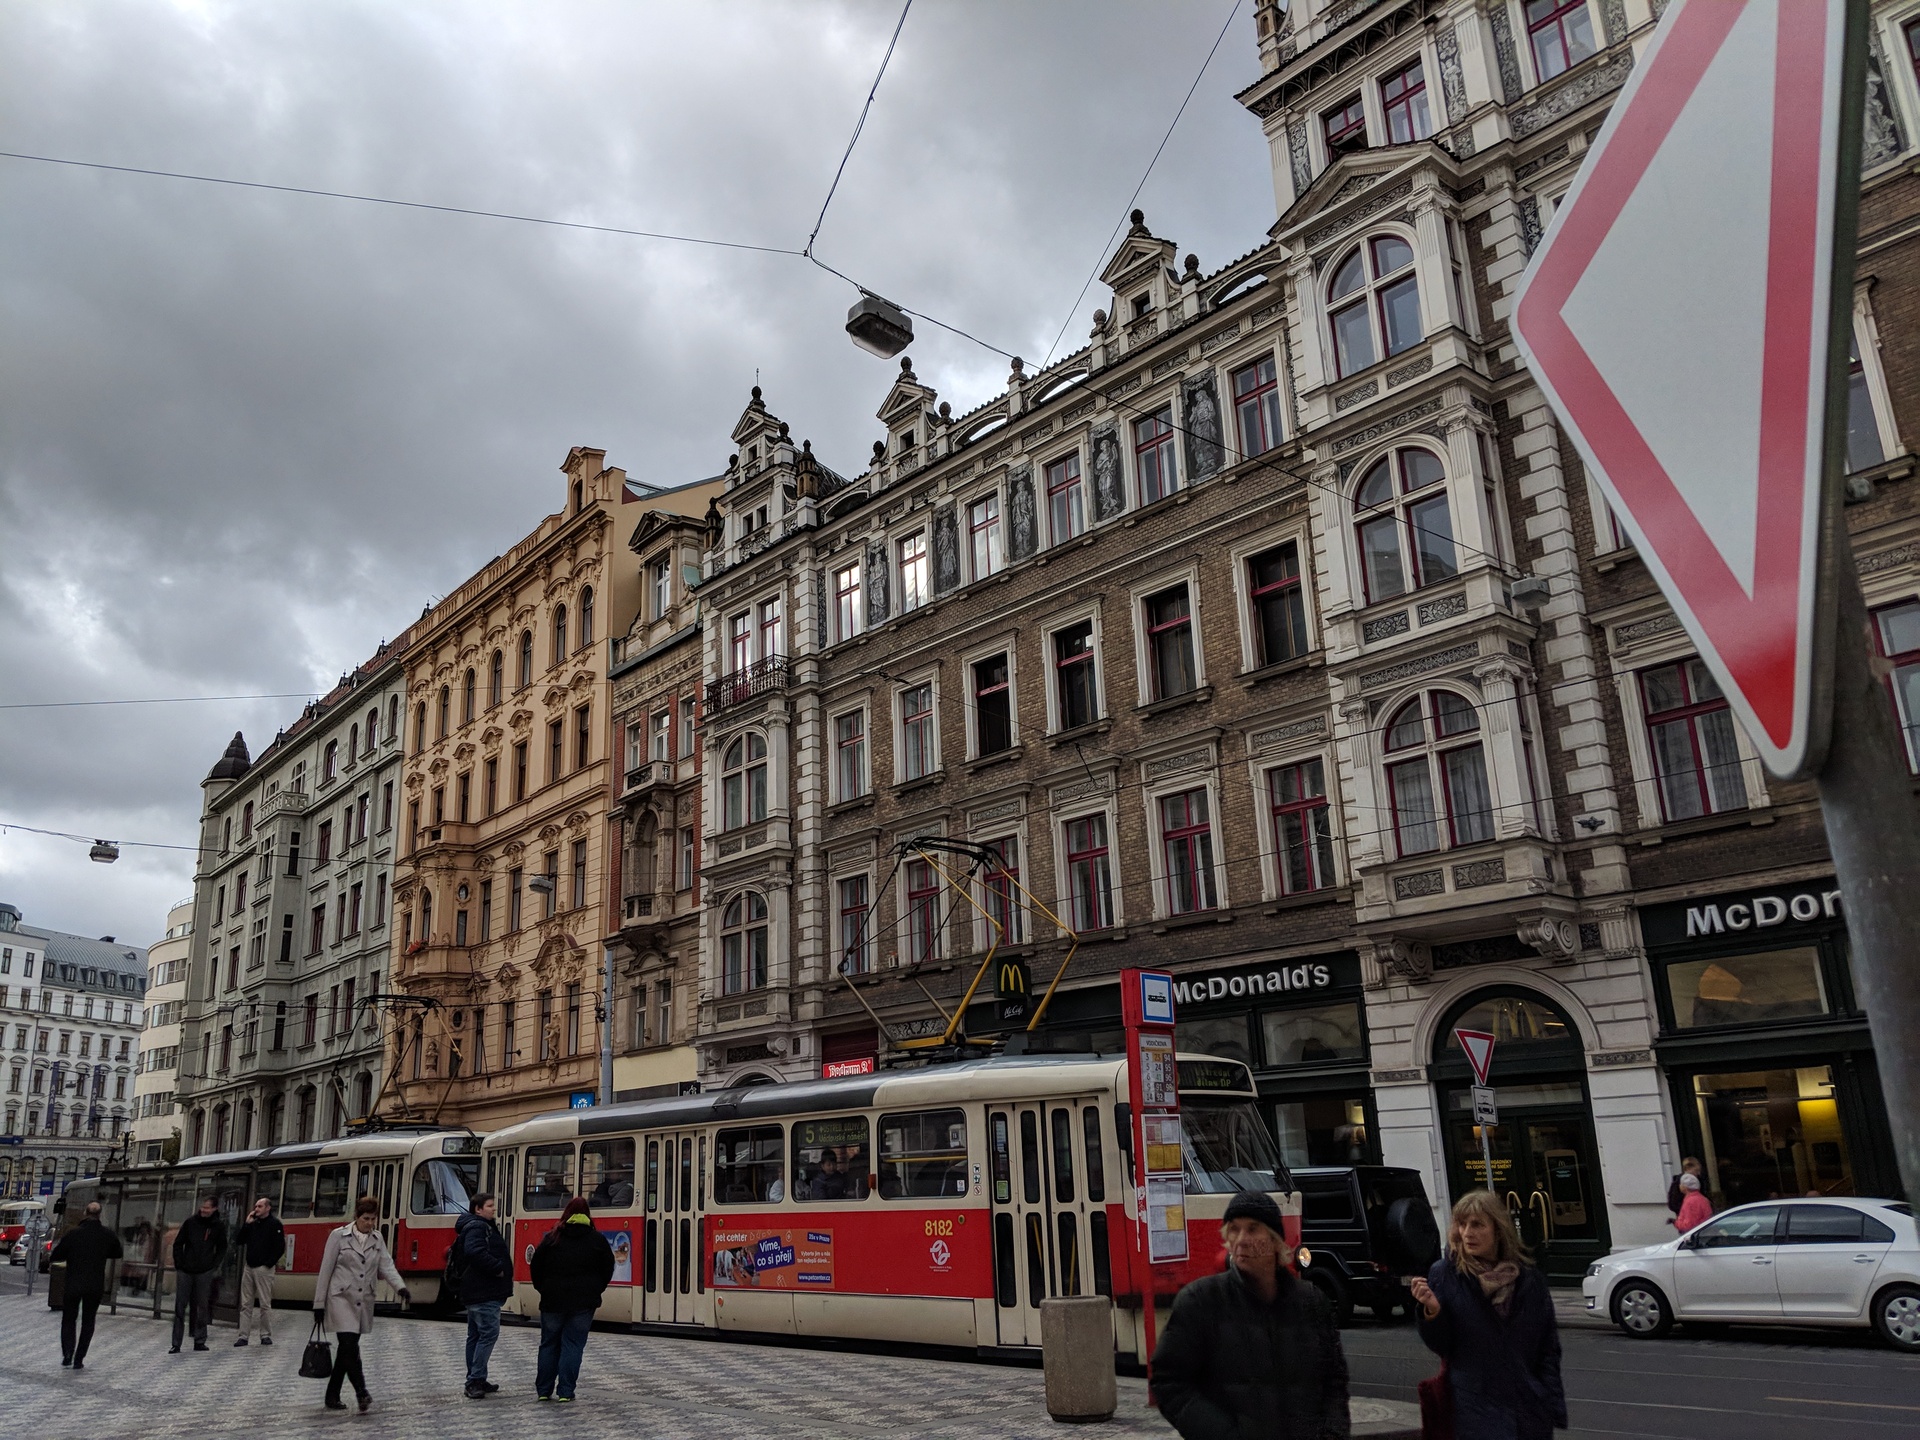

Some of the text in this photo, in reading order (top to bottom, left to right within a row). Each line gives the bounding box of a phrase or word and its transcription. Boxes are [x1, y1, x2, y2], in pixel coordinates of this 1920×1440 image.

[1173, 963, 1332, 1005] McDonald's
[805, 1125, 815, 1144] 5
[925, 1219, 953, 1236] 8182
[715, 1233, 725, 1244] pet
[759, 1240, 781, 1253] Víme,
[756, 1249, 793, 1267] co si přejí
